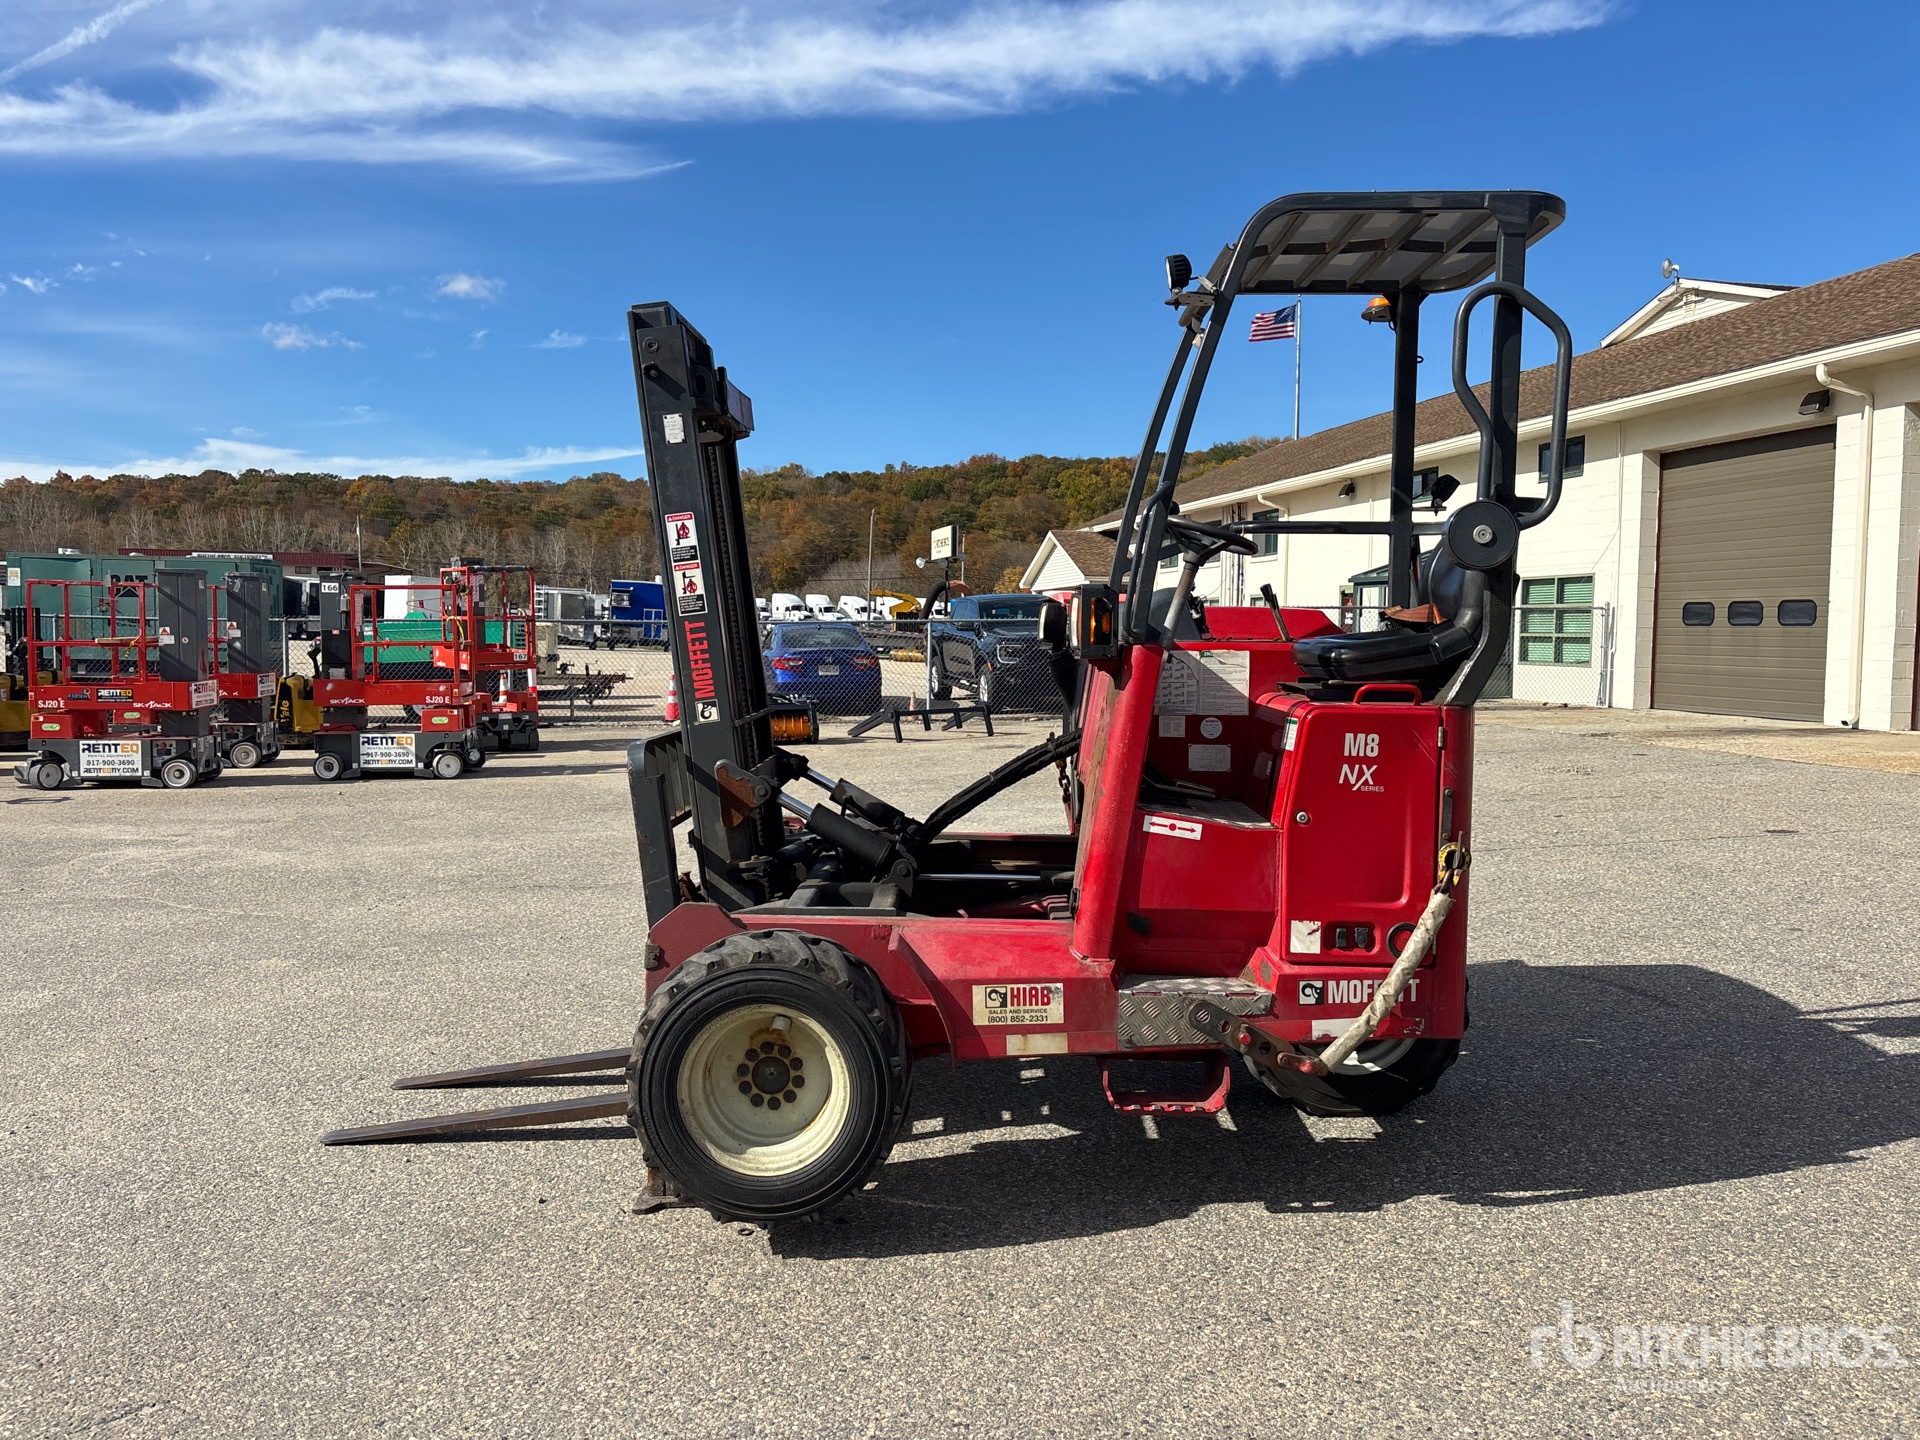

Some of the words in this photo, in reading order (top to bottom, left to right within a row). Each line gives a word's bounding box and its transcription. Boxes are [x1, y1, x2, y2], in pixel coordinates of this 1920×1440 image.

[322, 584, 339, 592] 166
[684, 620, 715, 698] MOFFETT
[38, 700, 58, 708] SJ20
[60, 700, 65, 708] E
[329, 696, 365, 704] SKYJACK
[361, 736, 413, 746] RENTEQ
[1344, 733, 1379, 757] M8
[82, 743, 139, 753] RENTEQ
[1339, 764, 1378, 791] NX
[1010, 986, 1051, 1006] HIAB
[987, 1015, 1008, 1024] (800)
